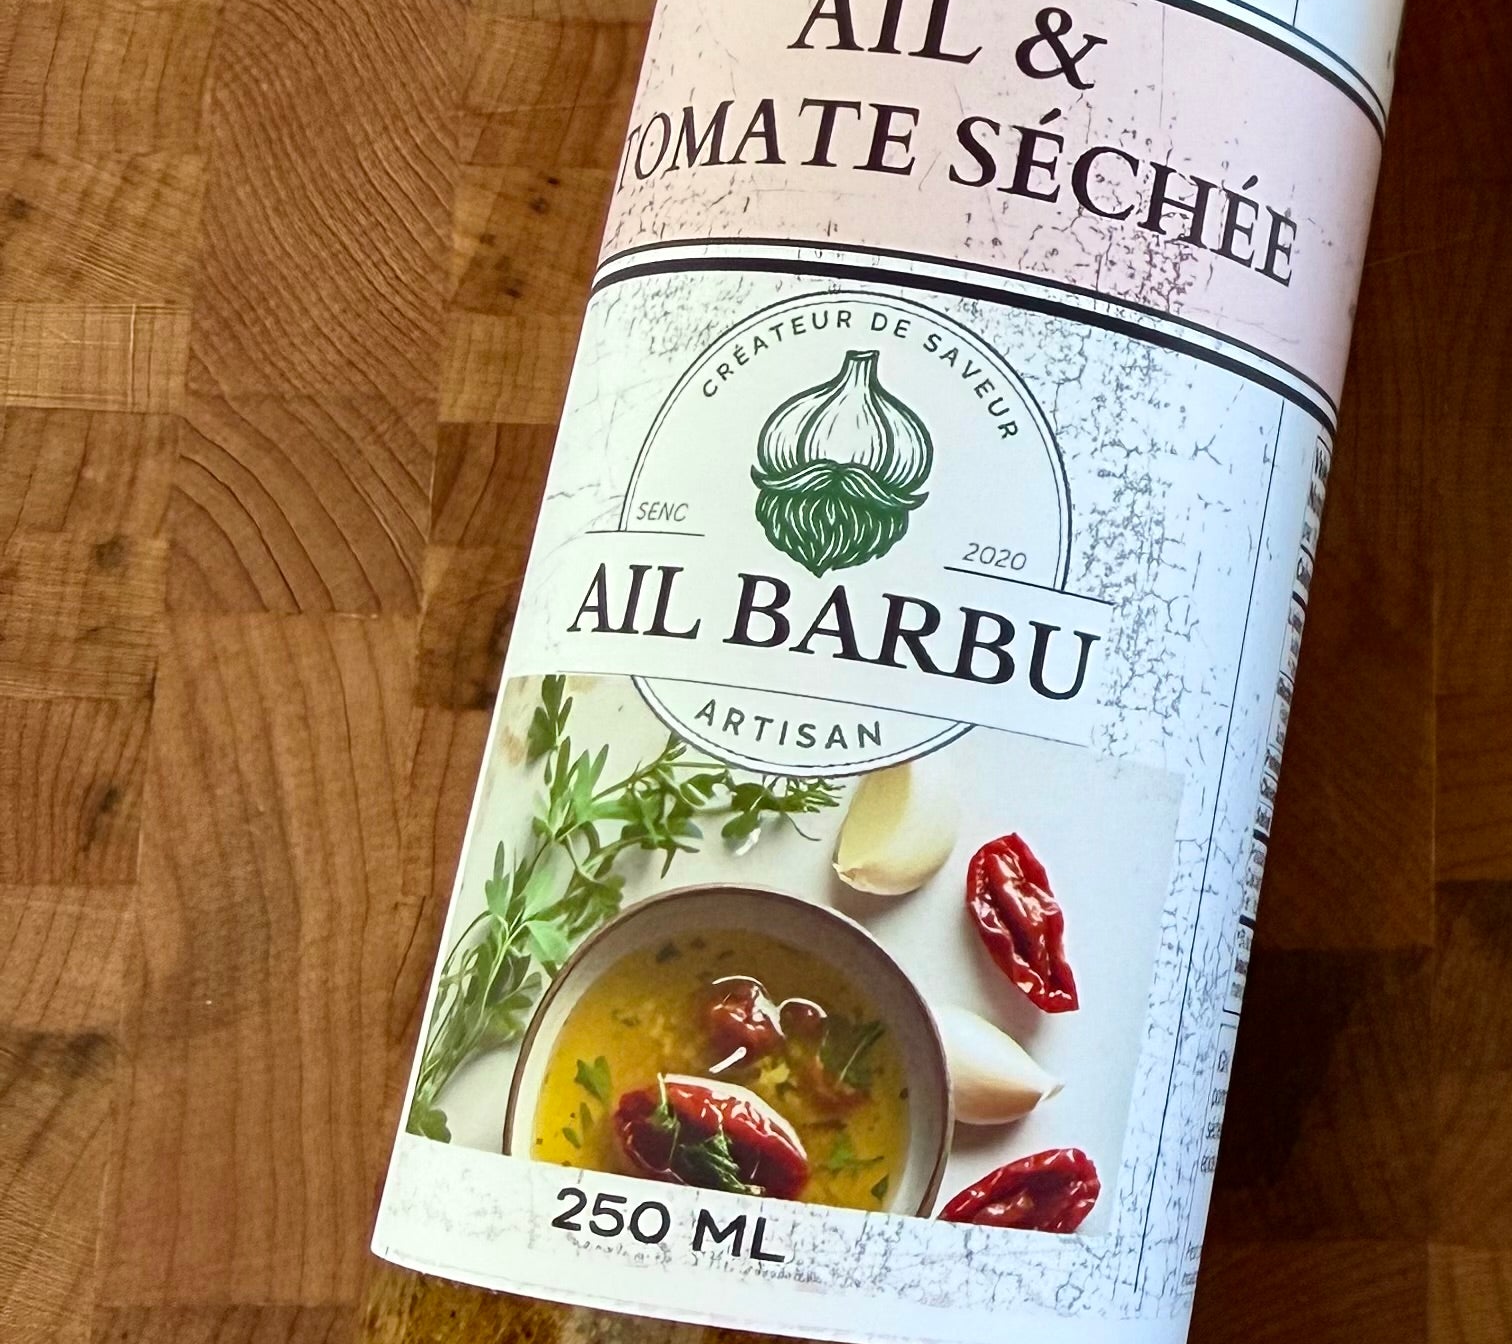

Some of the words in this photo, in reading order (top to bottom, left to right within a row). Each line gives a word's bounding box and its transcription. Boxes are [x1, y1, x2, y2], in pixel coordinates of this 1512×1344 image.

[1015, 6, 1108, 90] &
[948, 108, 1299, 288] SÉCHÉE
[702, 311, 852, 399] CRÉATEUR
[871, 314, 914, 338] DE
[921, 333, 1019, 442] SAVEUR
[636, 500, 688, 522] SENC
[962, 544, 1027, 571] 2020
[568, 563, 702, 640] AIL
[724, 574, 1101, 701] BARBU
[693, 699, 883, 751] ARTISAN
[552, 1188, 672, 1244] 250
[692, 1209, 786, 1262] ML
